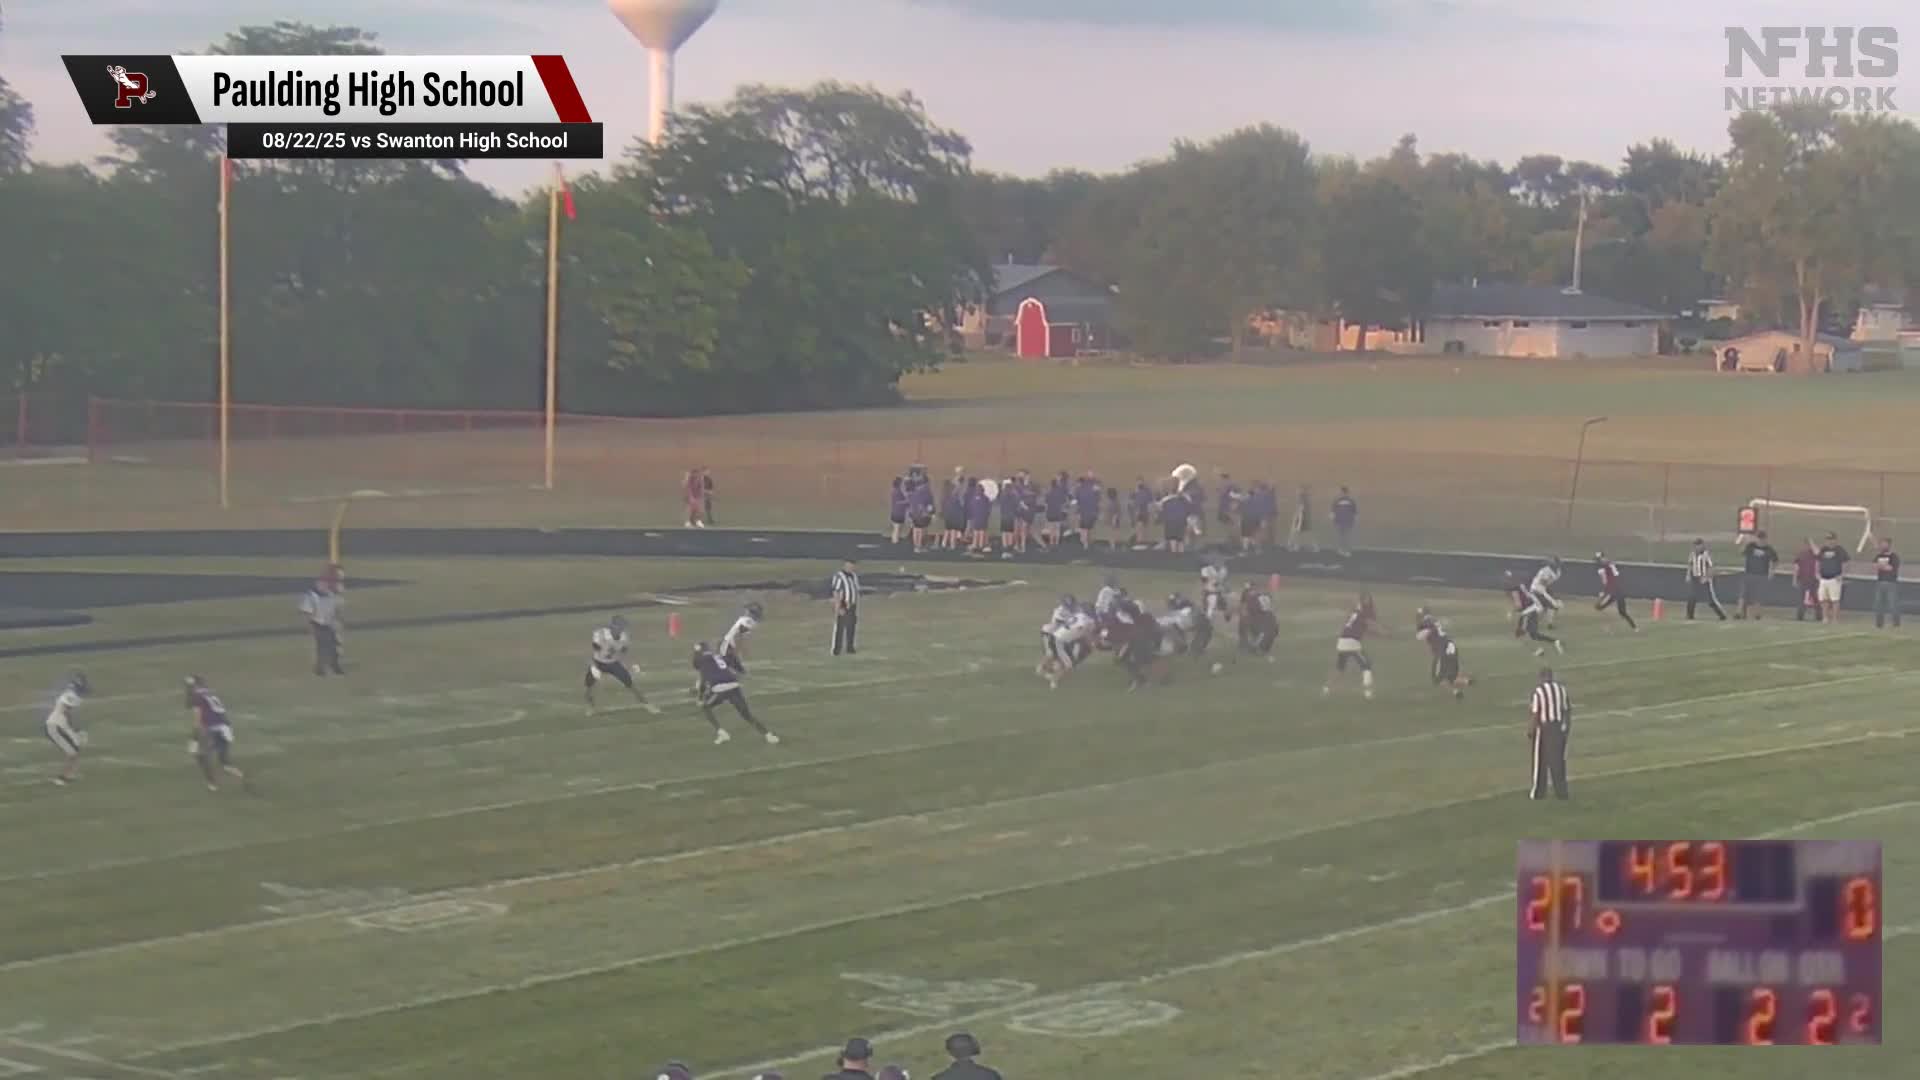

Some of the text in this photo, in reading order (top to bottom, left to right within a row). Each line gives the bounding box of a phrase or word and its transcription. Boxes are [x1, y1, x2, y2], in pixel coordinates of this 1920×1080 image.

[1527, 875, 1583, 930] 27
[1846, 878, 1874, 940] 0
[1560, 984, 1585, 1044] 2
[1650, 985, 1676, 1044] 2
[1749, 989, 1776, 1045] 2
[1808, 990, 1837, 1045] 2
